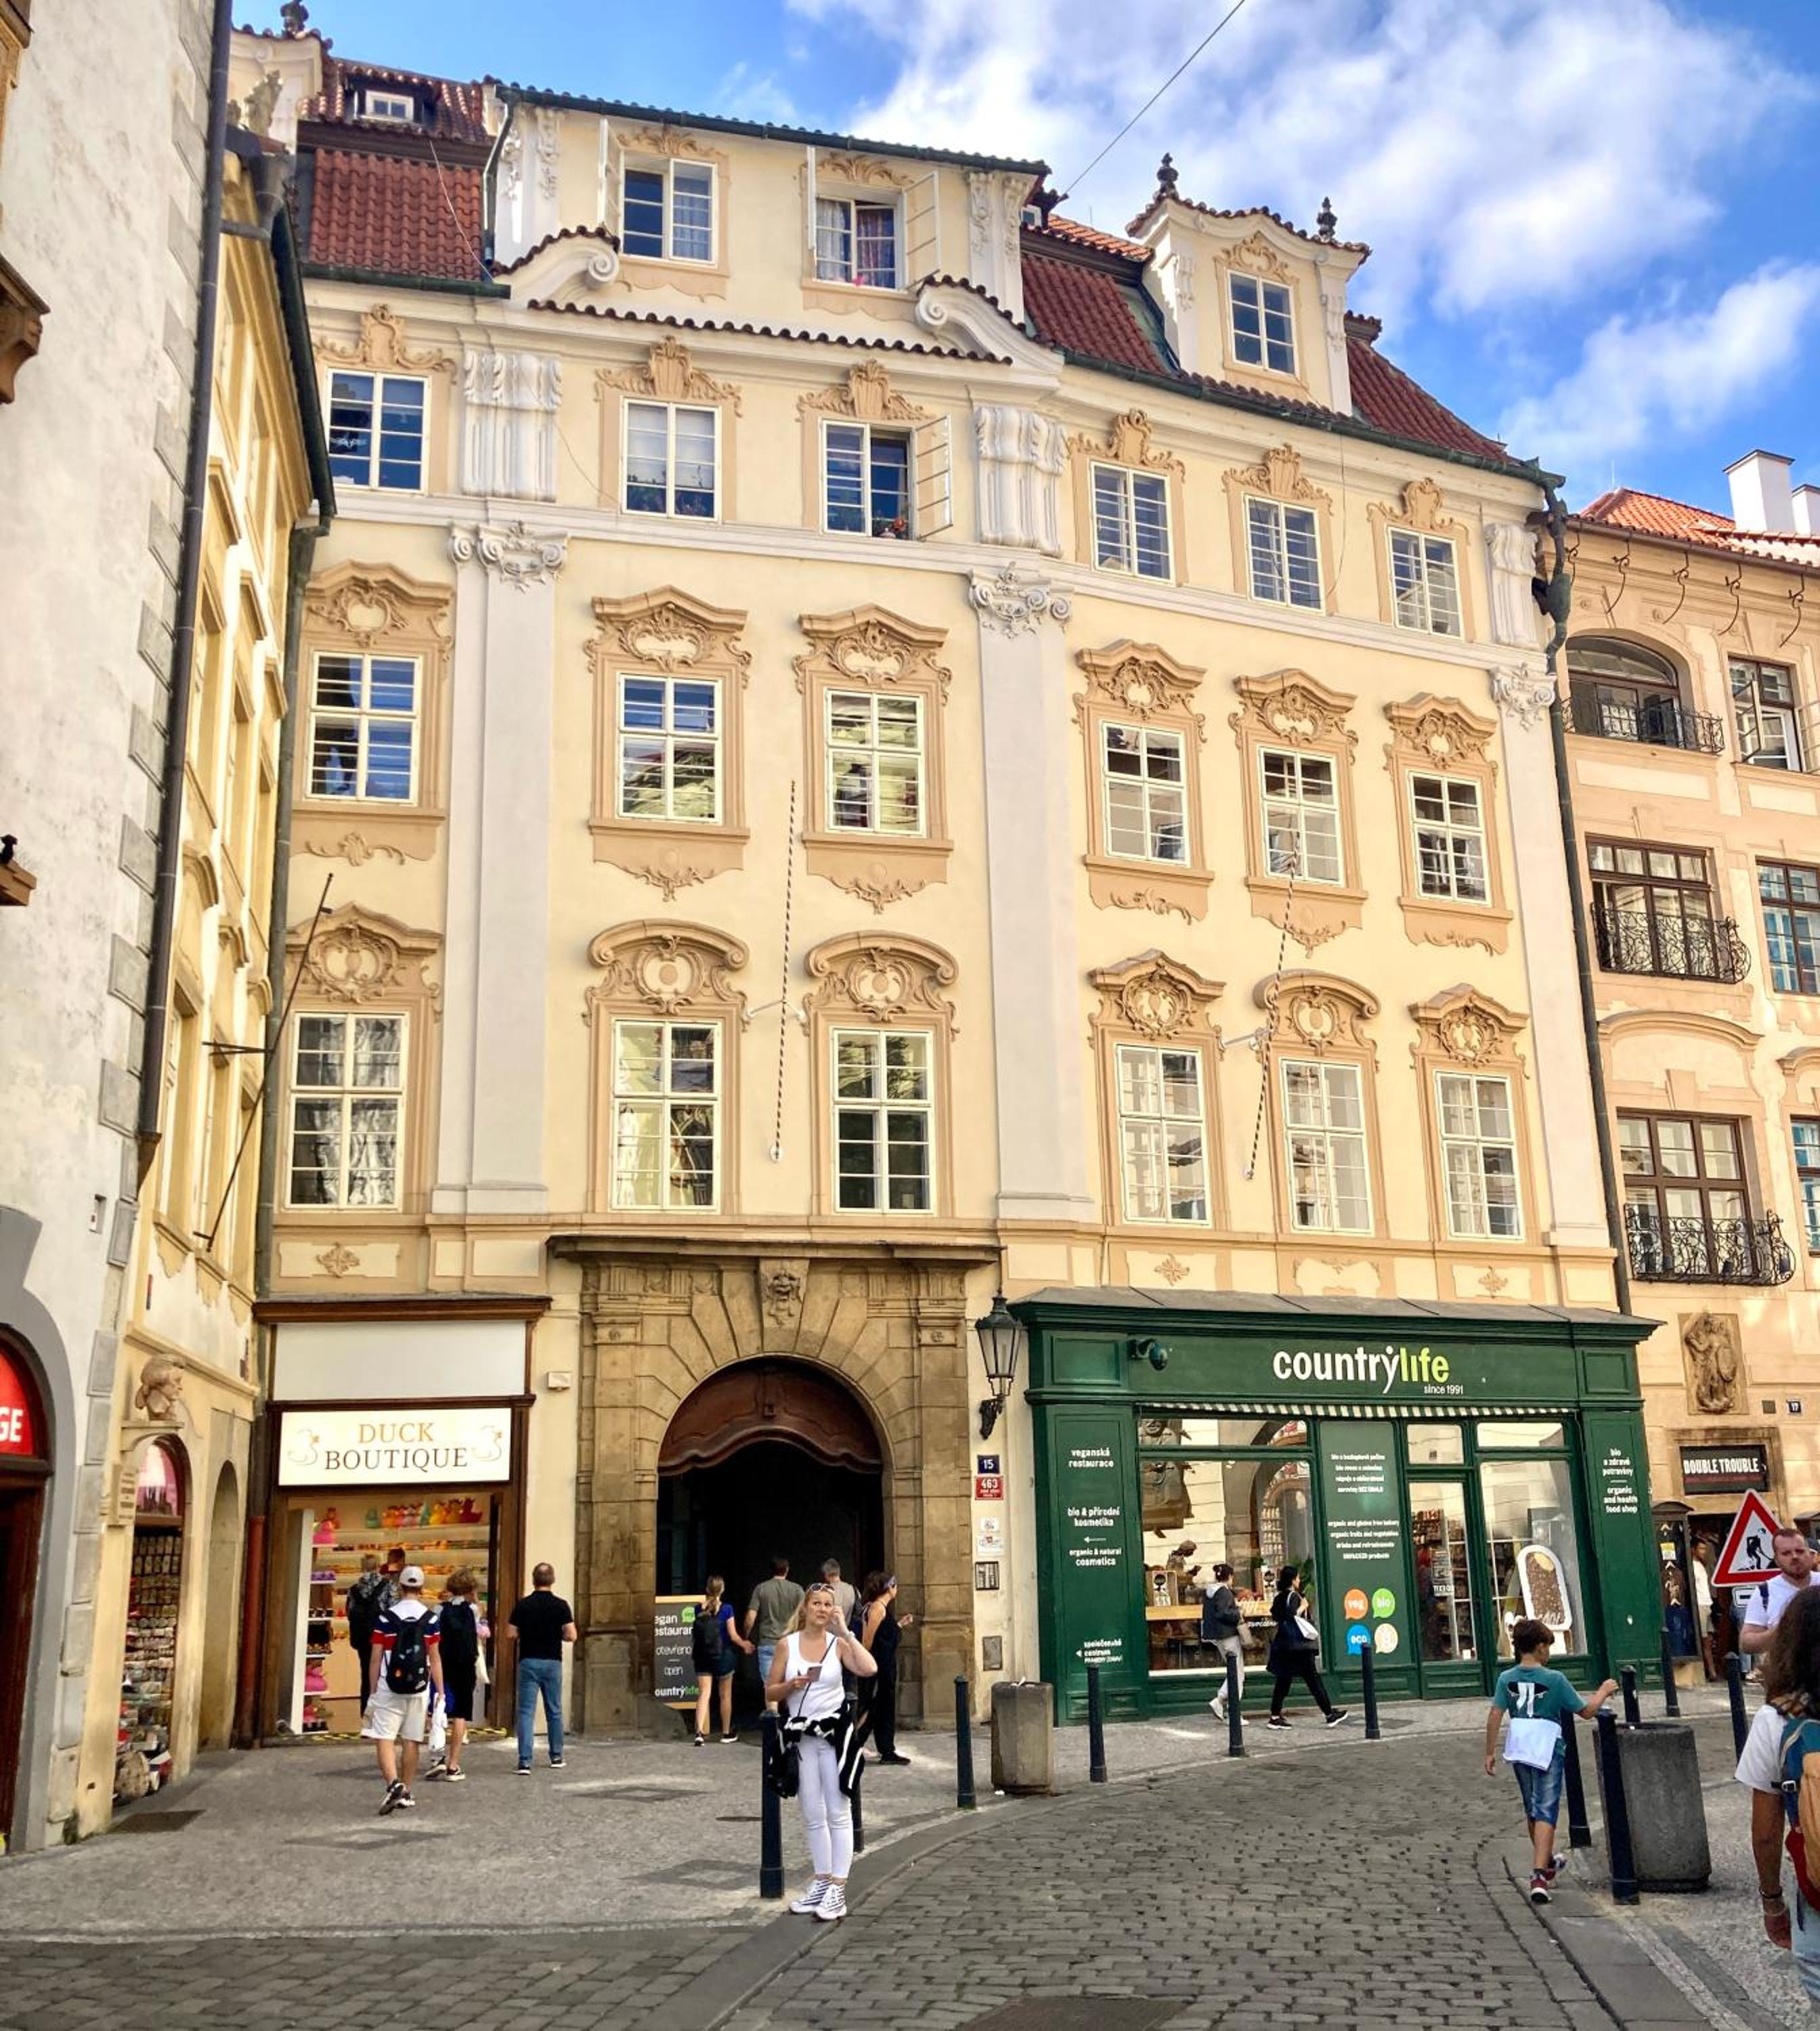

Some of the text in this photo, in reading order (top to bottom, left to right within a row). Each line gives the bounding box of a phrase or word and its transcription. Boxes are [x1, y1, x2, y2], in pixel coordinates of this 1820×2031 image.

[1424, 1384, 1463, 1395] since 1991
[359, 1422, 434, 1444] DUCK
[1071, 1447, 1110, 1458] veganská
[325, 1447, 468, 1472] BOUTIQUE
[984, 1459, 995, 1470] 15
[1069, 1459, 1114, 1468] restaurace
[1683, 1458, 1760, 1475] DOUBLE TROUBLE
[981, 1478, 999, 1489] 463
[1068, 1506, 1120, 1517] bio & přírodní
[1622, 1505, 1638, 1514] shop
[1074, 1518, 1114, 1527] kosmetika
[1069, 1548, 1093, 1556] organic
[1100, 1548, 1121, 1556] natural
[1076, 1556, 1116, 1566] cosmetics
